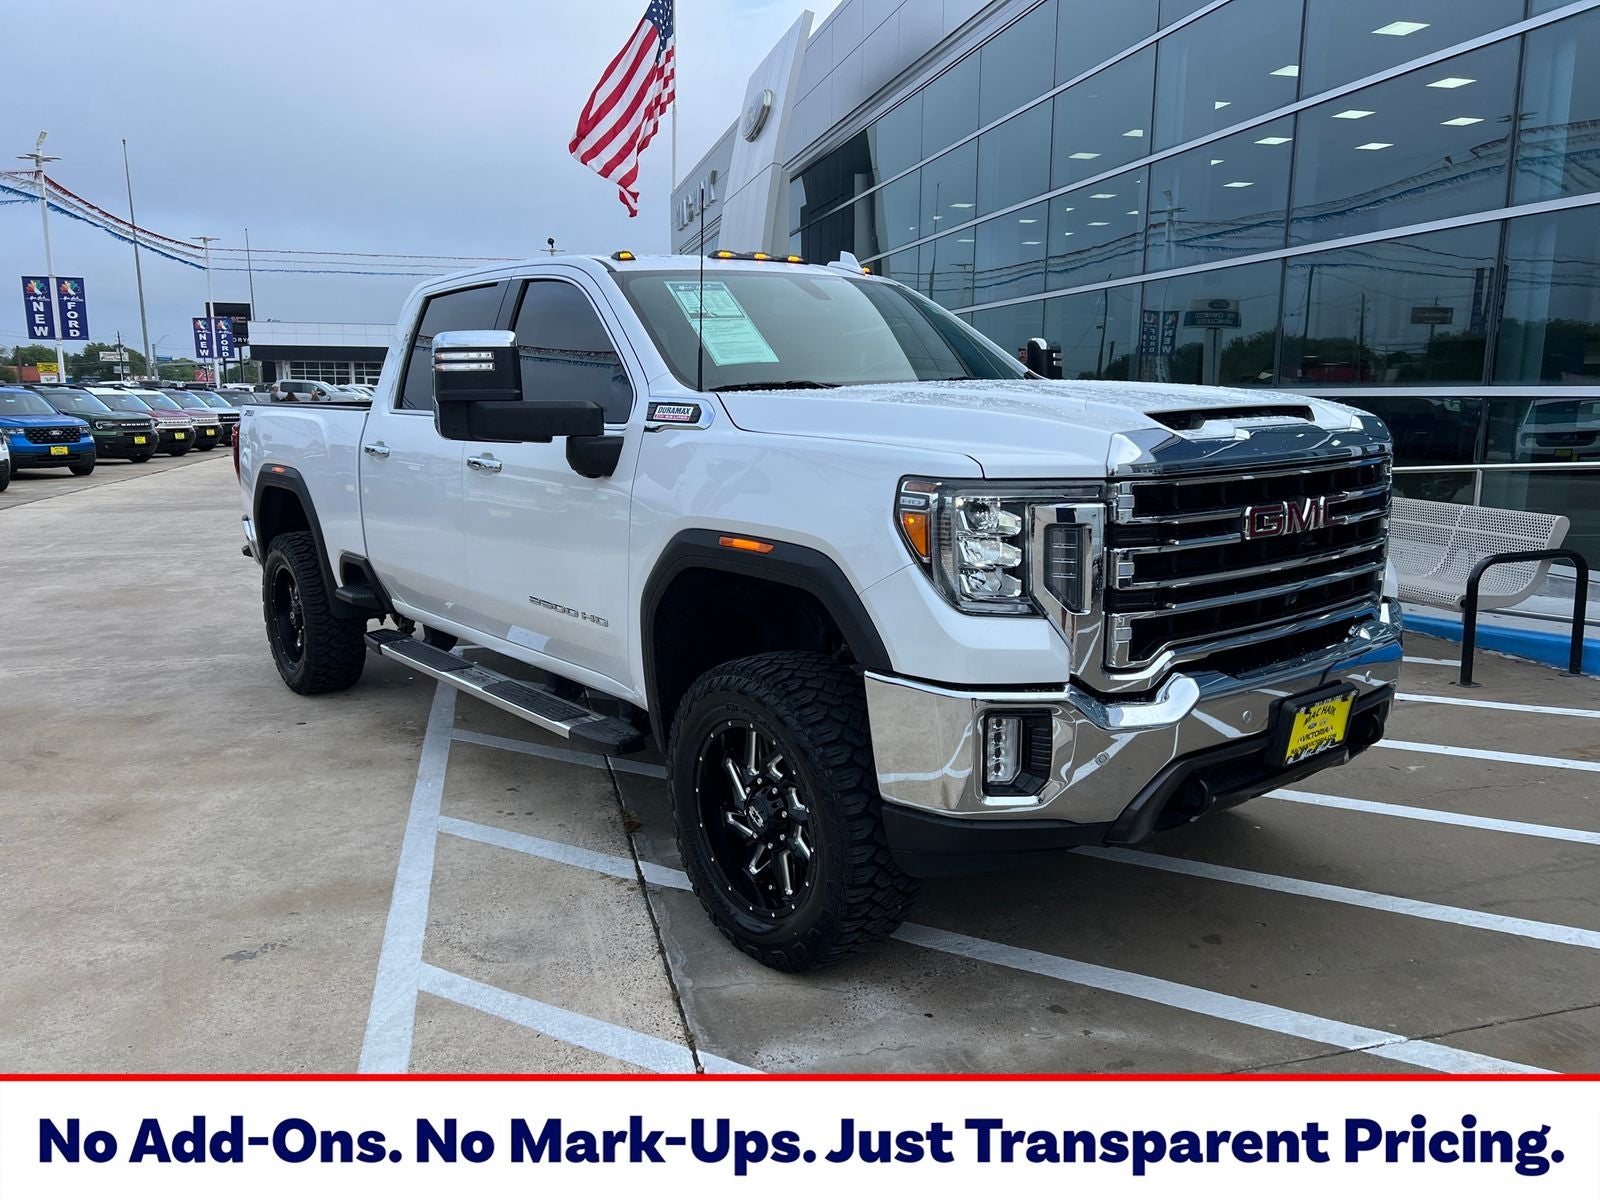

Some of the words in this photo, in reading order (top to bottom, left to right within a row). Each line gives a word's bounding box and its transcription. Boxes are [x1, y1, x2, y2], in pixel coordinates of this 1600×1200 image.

[32, 301, 49, 337] NEW
[66, 301, 80, 337] FORD
[199, 333, 210, 357] NEW
[220, 333, 230, 357] FORD
[657, 406, 692, 415] DURAMAX
[1243, 491, 1350, 540] GMC
[581, 610, 609, 628] HD
